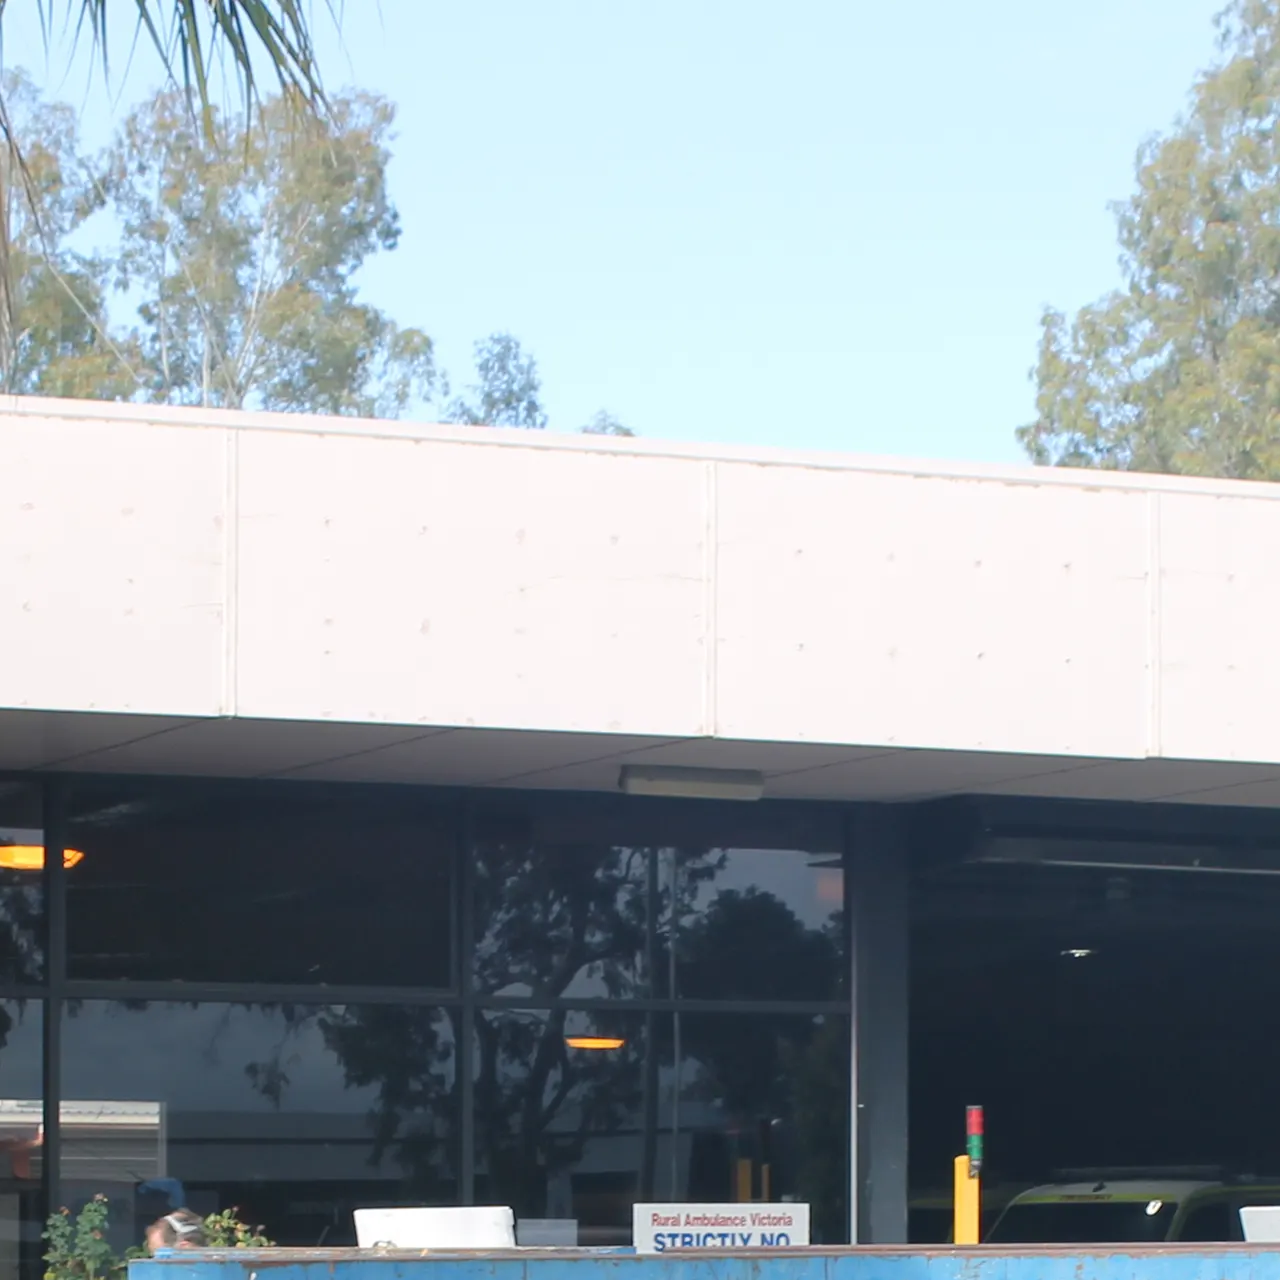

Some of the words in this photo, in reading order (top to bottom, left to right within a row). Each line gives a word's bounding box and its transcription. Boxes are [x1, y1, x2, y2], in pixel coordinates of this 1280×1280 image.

[651, 1213, 681, 1227] Rural
[684, 1213, 747, 1227] Ambulance
[750, 1212, 793, 1227] Victoria
